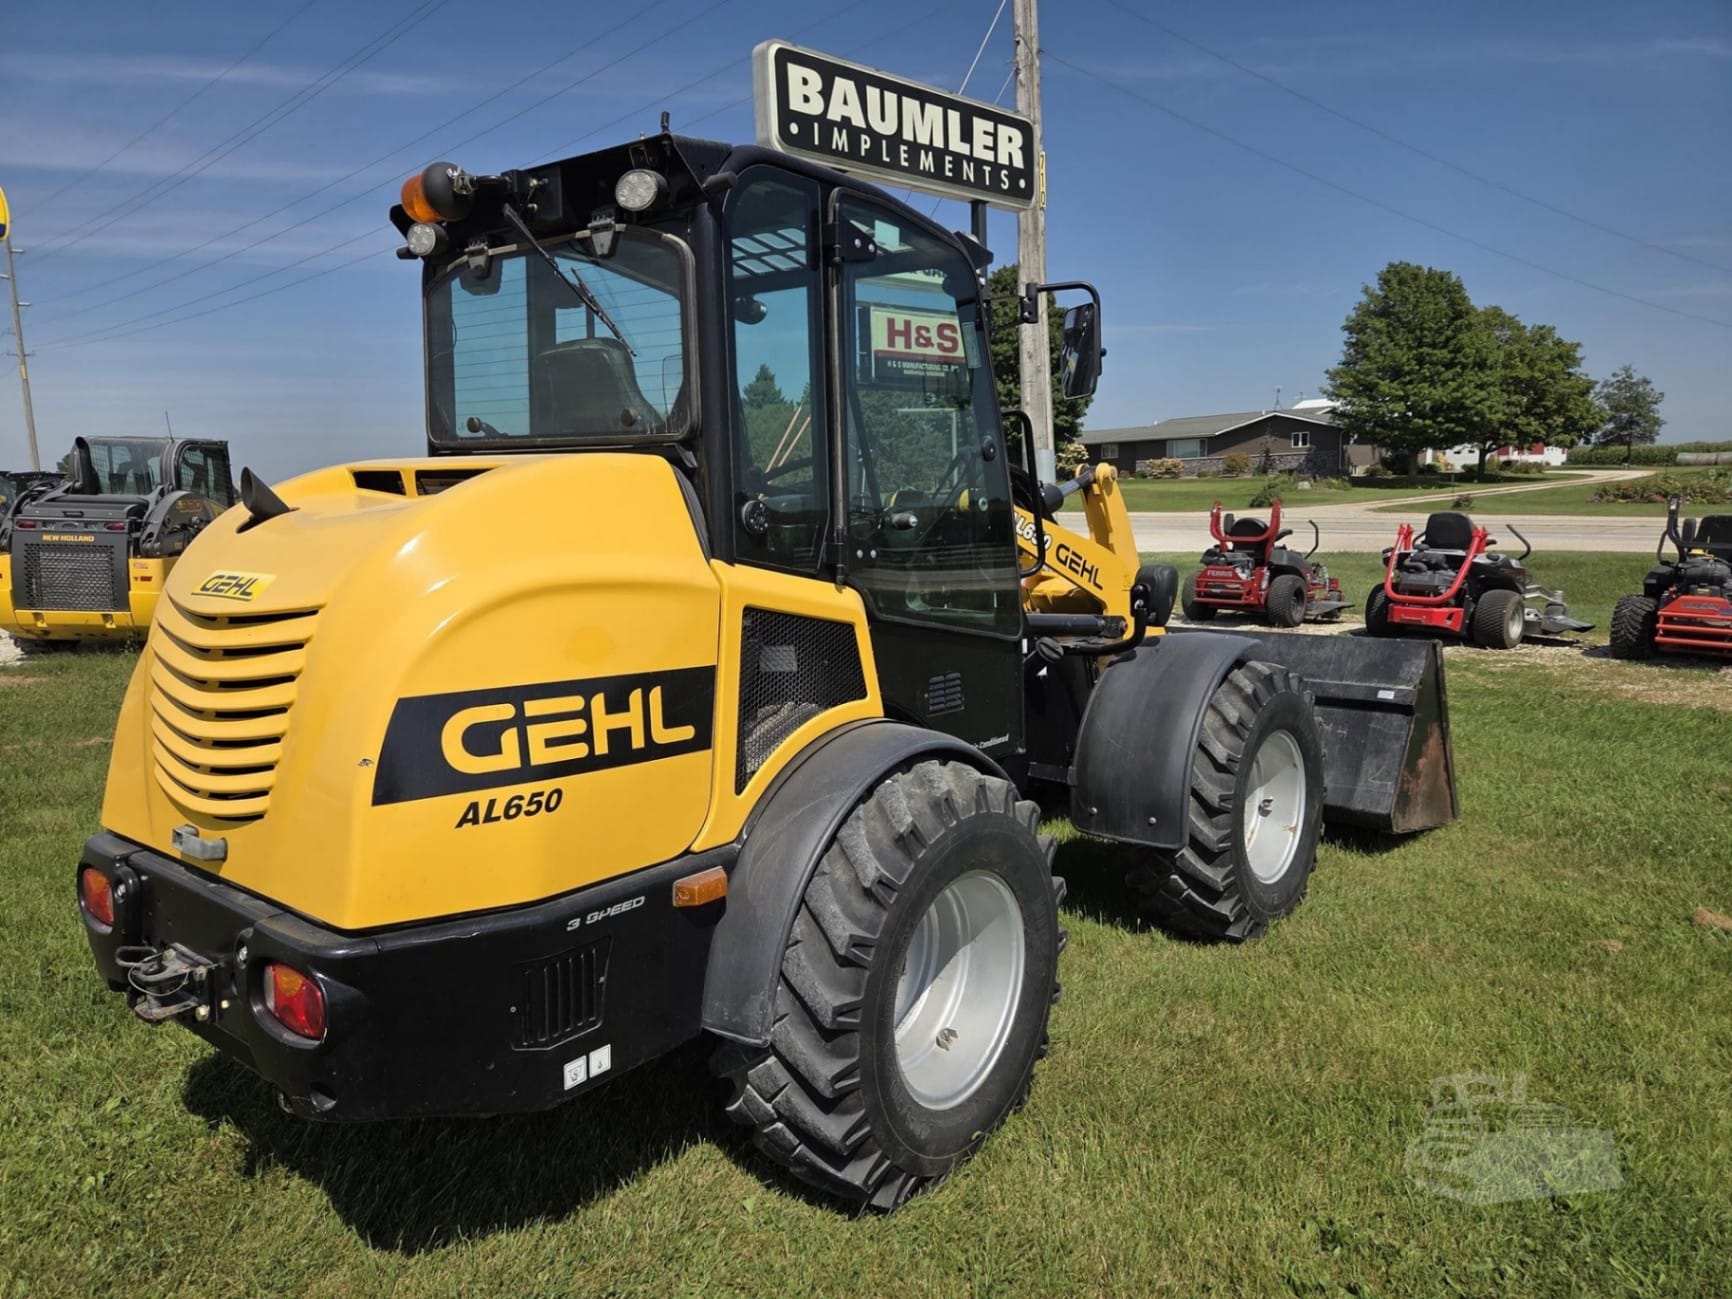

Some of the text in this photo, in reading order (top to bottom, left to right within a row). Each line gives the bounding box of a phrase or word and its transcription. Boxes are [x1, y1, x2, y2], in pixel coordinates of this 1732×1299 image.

[787, 62, 1024, 169] BAUMLER
[814, 122, 1009, 189] IMPLEMENTS
[887, 317, 959, 353] H&S
[42, 534, 60, 542] NEW
[200, 574, 258, 597] GEHL
[1056, 543, 1103, 591] GEHL
[1207, 570, 1233, 578] FERRIS
[441, 685, 695, 774] GEHL
[455, 788, 563, 829] AL650
[566, 896, 645, 931] 3 SPEED
